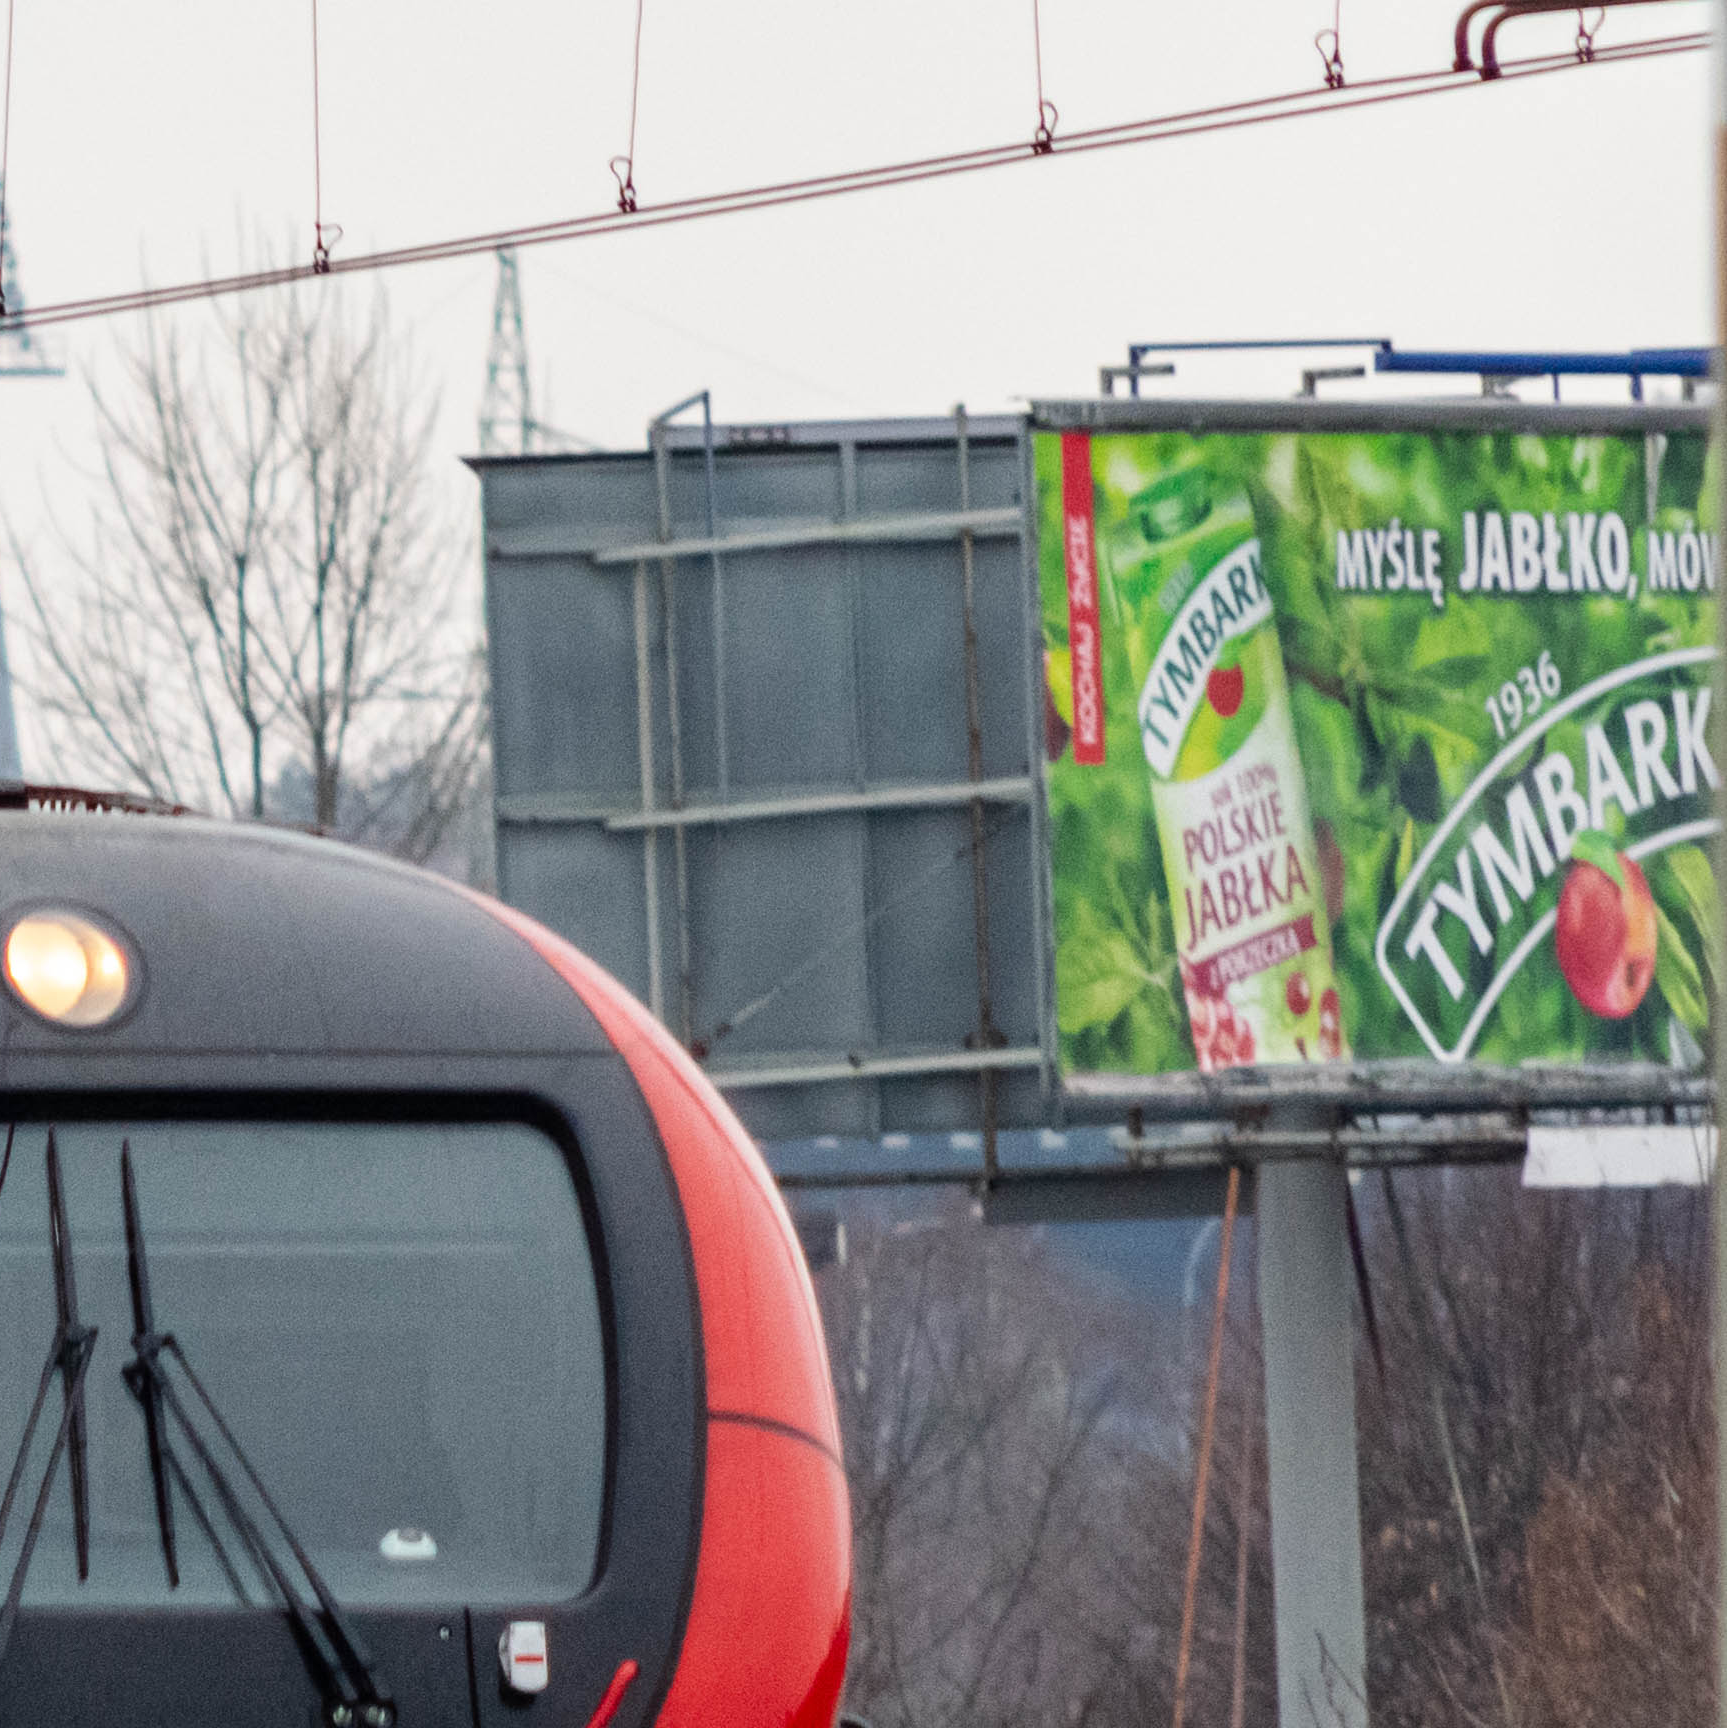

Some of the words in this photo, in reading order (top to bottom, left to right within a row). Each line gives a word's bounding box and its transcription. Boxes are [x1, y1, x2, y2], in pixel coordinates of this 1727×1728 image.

[1336, 517, 1445, 608] MYŚLĘ
[1458, 510, 1640, 600] JABŁKO,
[1484, 648, 1562, 740] 1936
[1182, 792, 1287, 875] POLSKIE
[1403, 685, 1723, 1003] TYMBARK
[1183, 844, 1310, 953] JABŁKA
